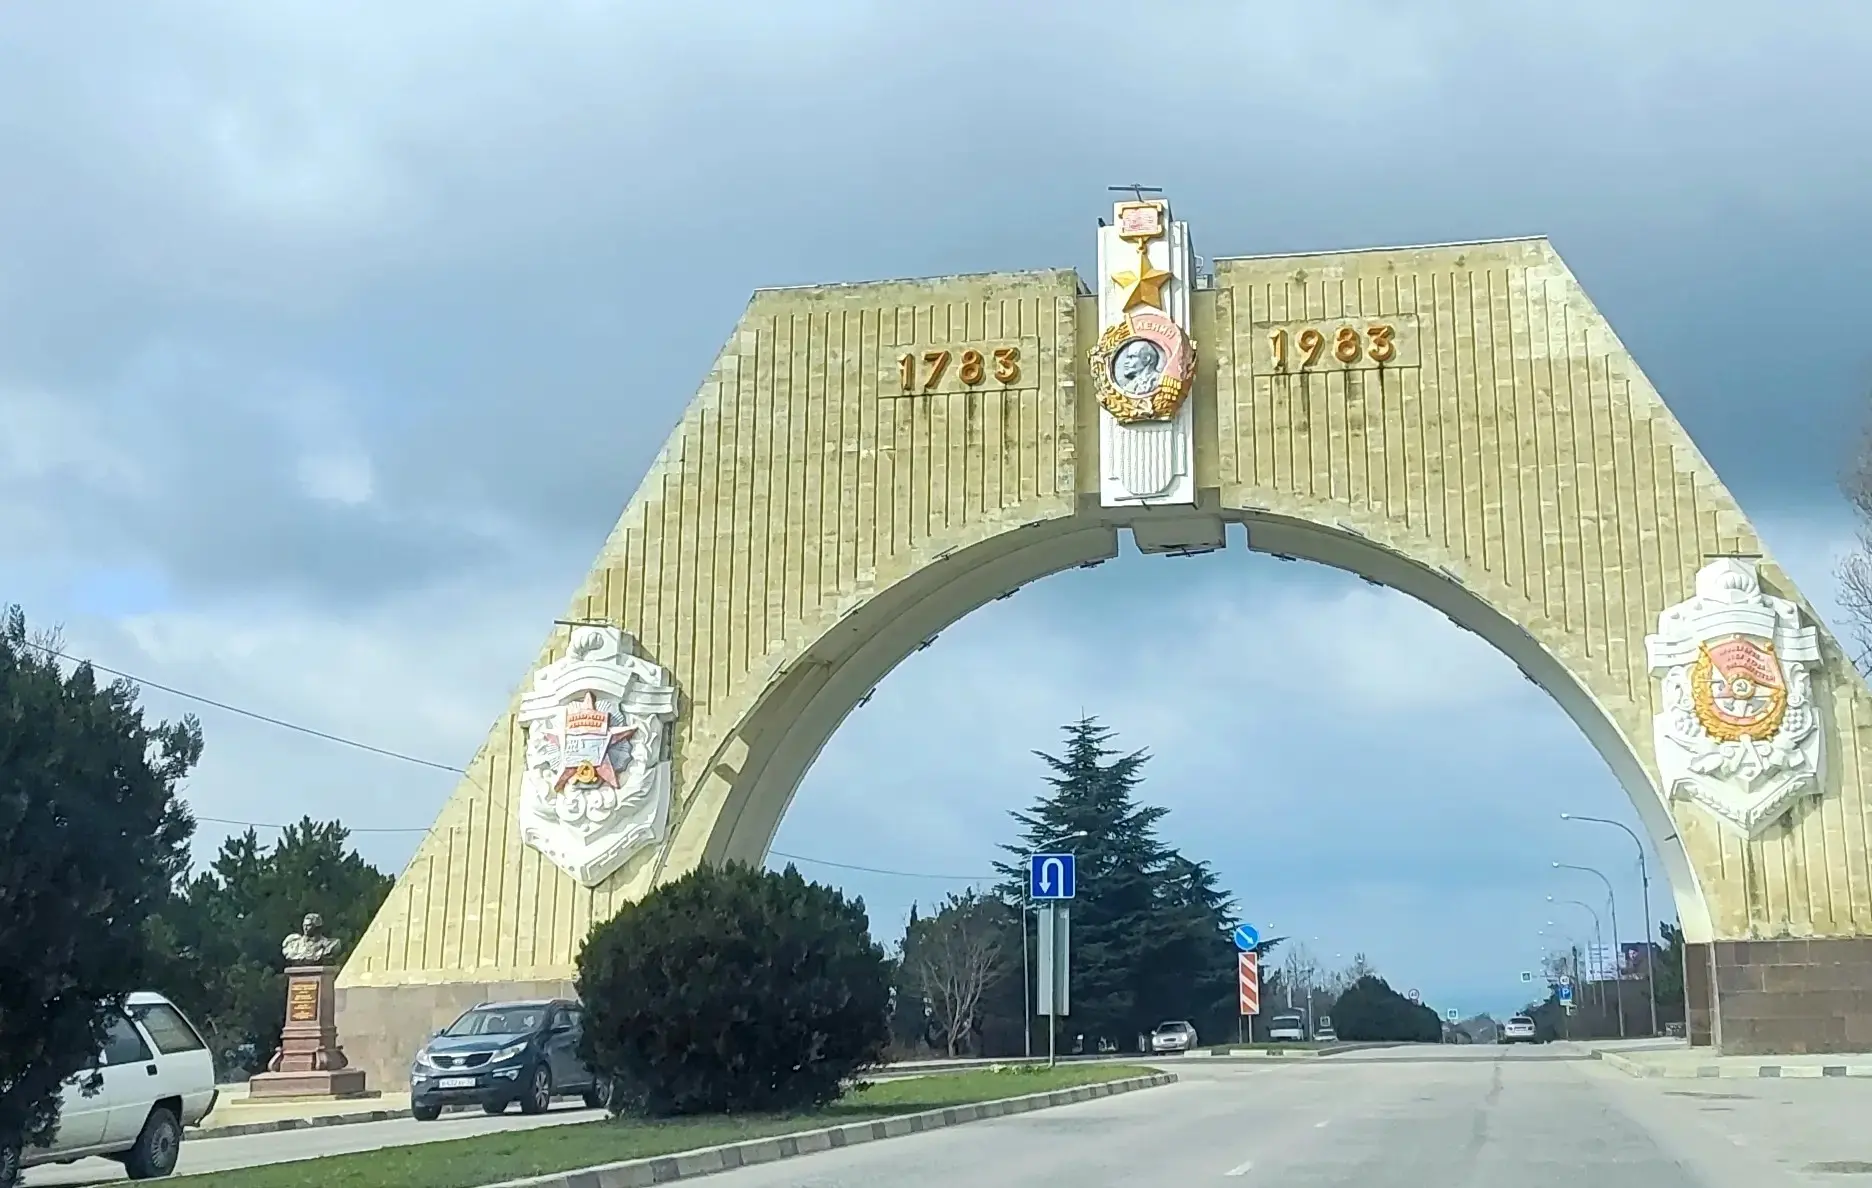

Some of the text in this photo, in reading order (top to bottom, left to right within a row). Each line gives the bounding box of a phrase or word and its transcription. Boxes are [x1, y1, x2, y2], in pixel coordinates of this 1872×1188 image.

[1136, 320, 1177, 340] ЛЕНИН
[1268, 325, 1395, 369] 1983
[897, 347, 1020, 390] 1783
